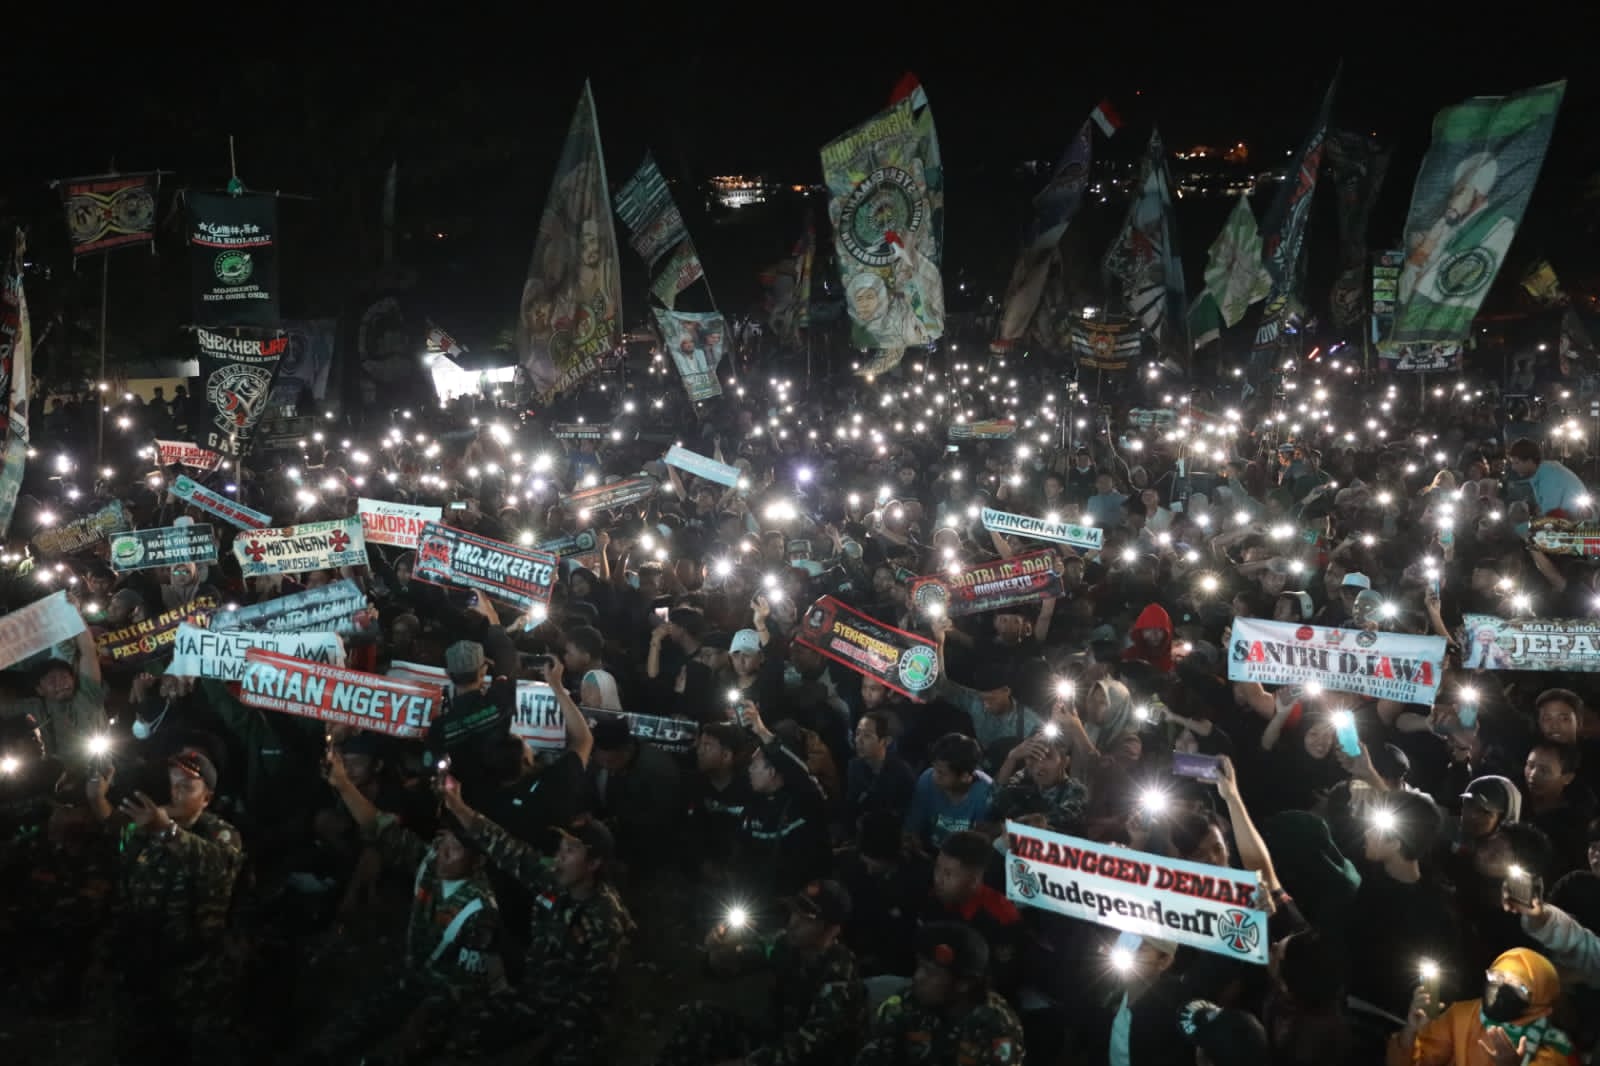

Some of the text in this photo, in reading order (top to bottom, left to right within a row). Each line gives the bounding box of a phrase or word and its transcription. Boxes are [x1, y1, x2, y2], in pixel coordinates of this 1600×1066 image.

[193, 232, 222, 244] MAFIA
[148, 544, 214, 561] PASURUAN
[454, 541, 554, 587] MOJOKERTO
[974, 575, 1033, 595] MOJOKERTO
[97, 619, 155, 645] SANTRI
[1522, 623, 1563, 633] MAFIA
[1233, 639, 1331, 674] SANTRI
[1512, 633, 1600, 658] JEPA
[200, 658, 247, 681] LUMA
[241, 660, 328, 706] KRIAN
[331, 682, 434, 728] NGEYEL
[514, 692, 563, 727] NTRI
[1009, 833, 1257, 908] MRANGGEN DEMAK
[1038, 871, 1219, 937] IndependenT
